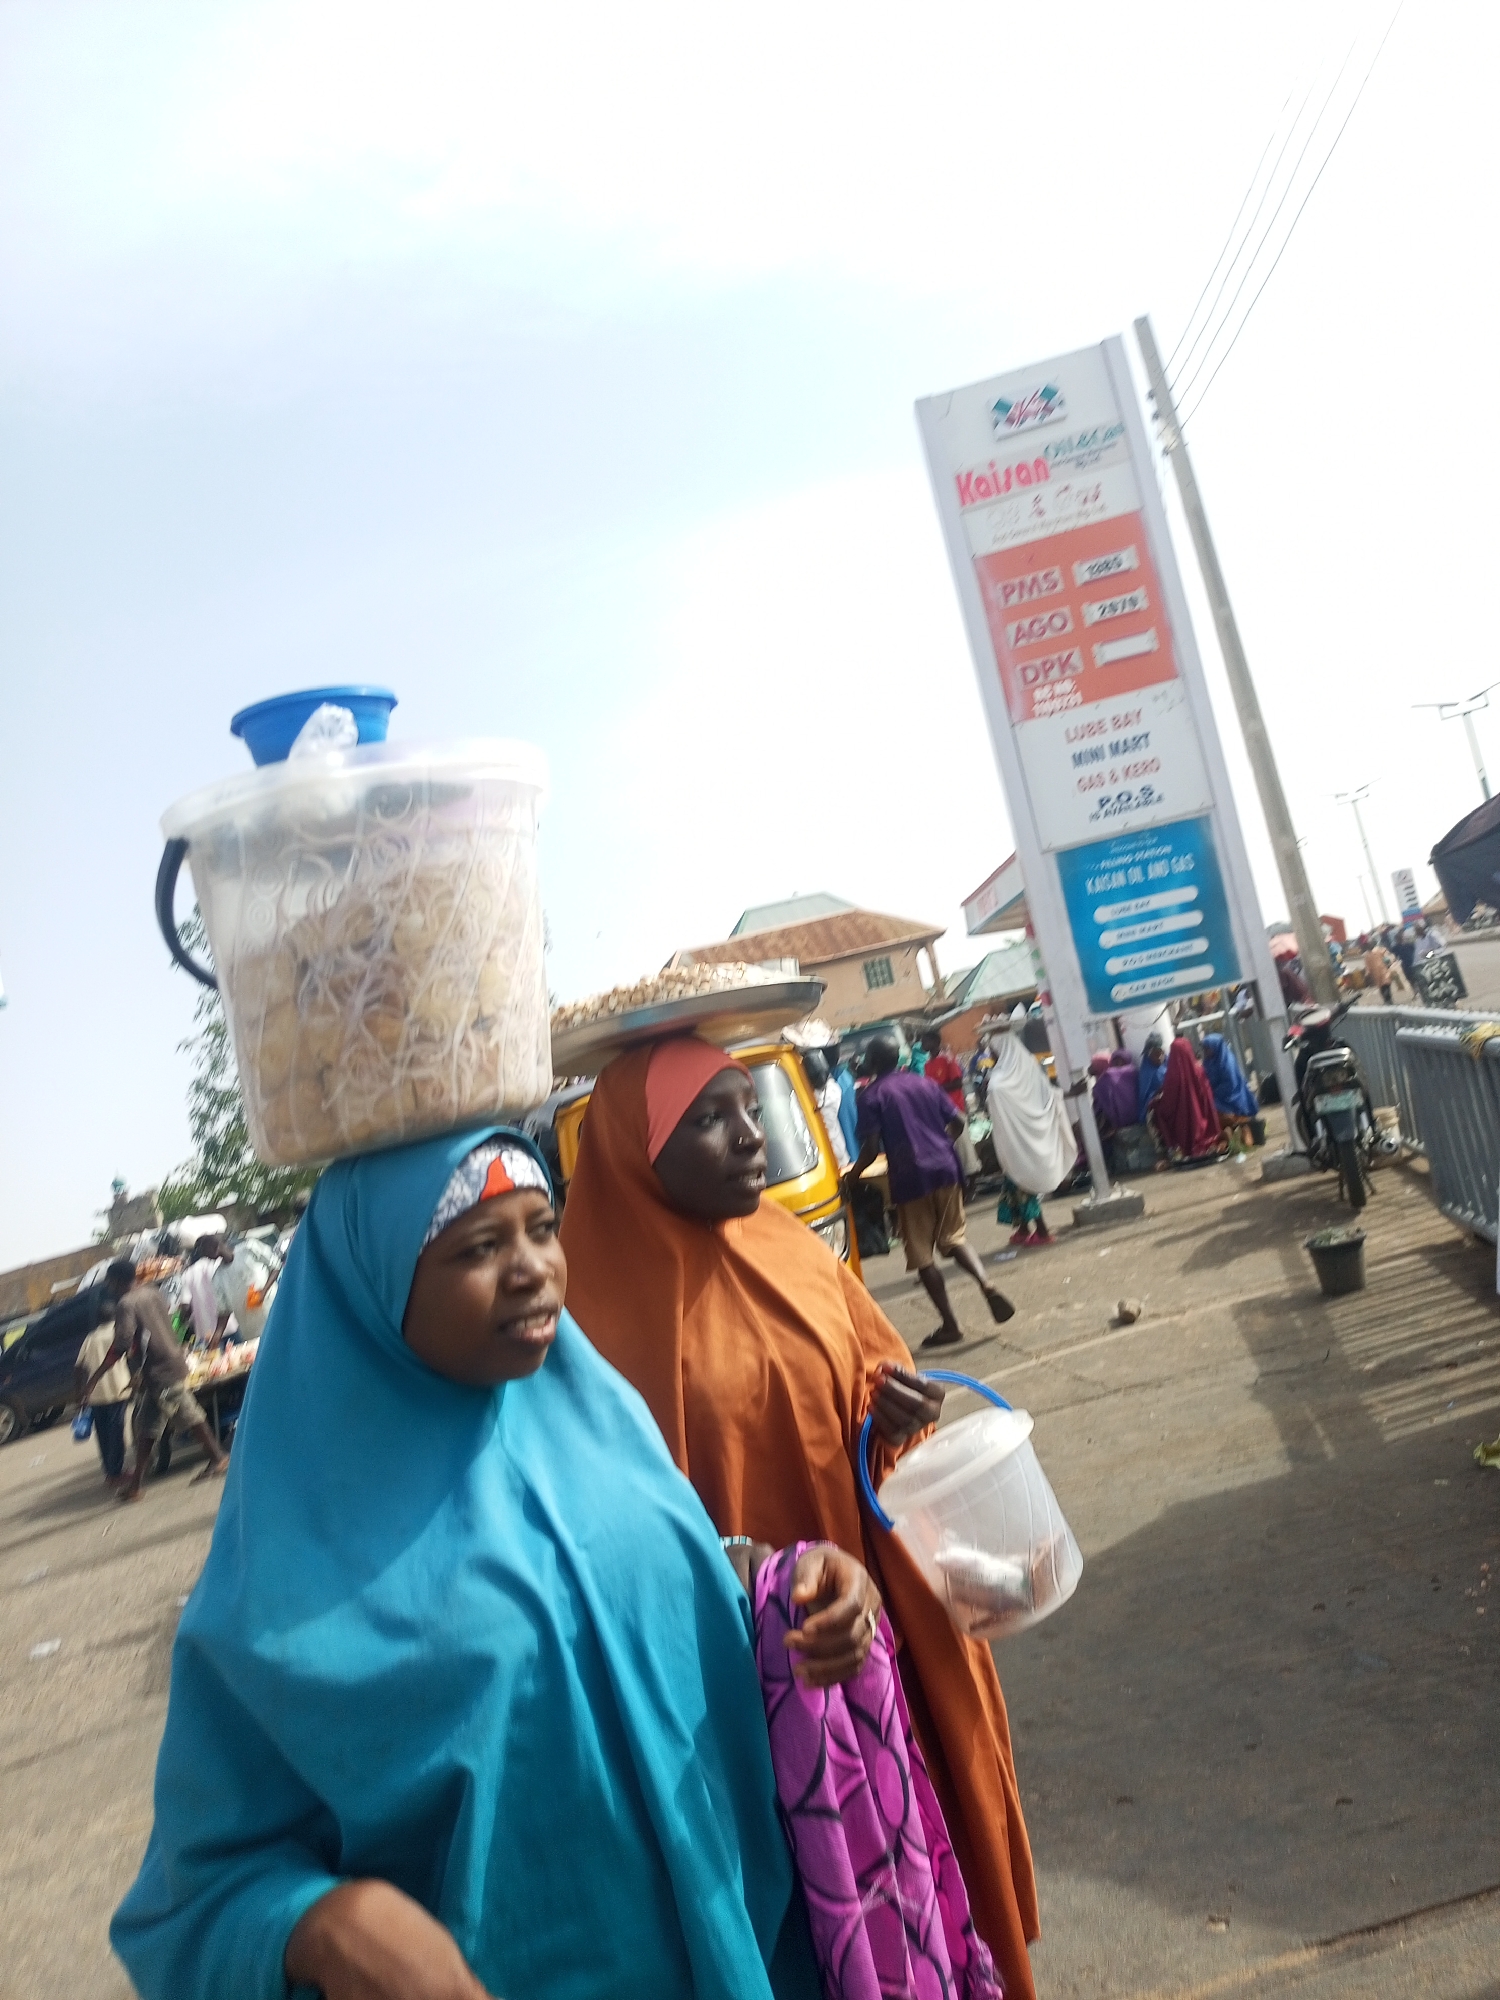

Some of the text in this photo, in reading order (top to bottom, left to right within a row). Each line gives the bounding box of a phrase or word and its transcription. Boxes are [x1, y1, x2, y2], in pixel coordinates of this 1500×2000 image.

[956, 456, 1050, 507] Kaisan
[1001, 570, 1060, 604] PMS
[1014, 611, 1069, 647] AGO
[1020, 650, 1078, 686] DPK
[1064, 707, 1142, 745] LUBE BAY
[1071, 731, 1151, 769] MINI MART
[1077, 757, 1161, 793] GAS & KERO
[1085, 853, 1195, 896] KAISAN OIL AND GAS
